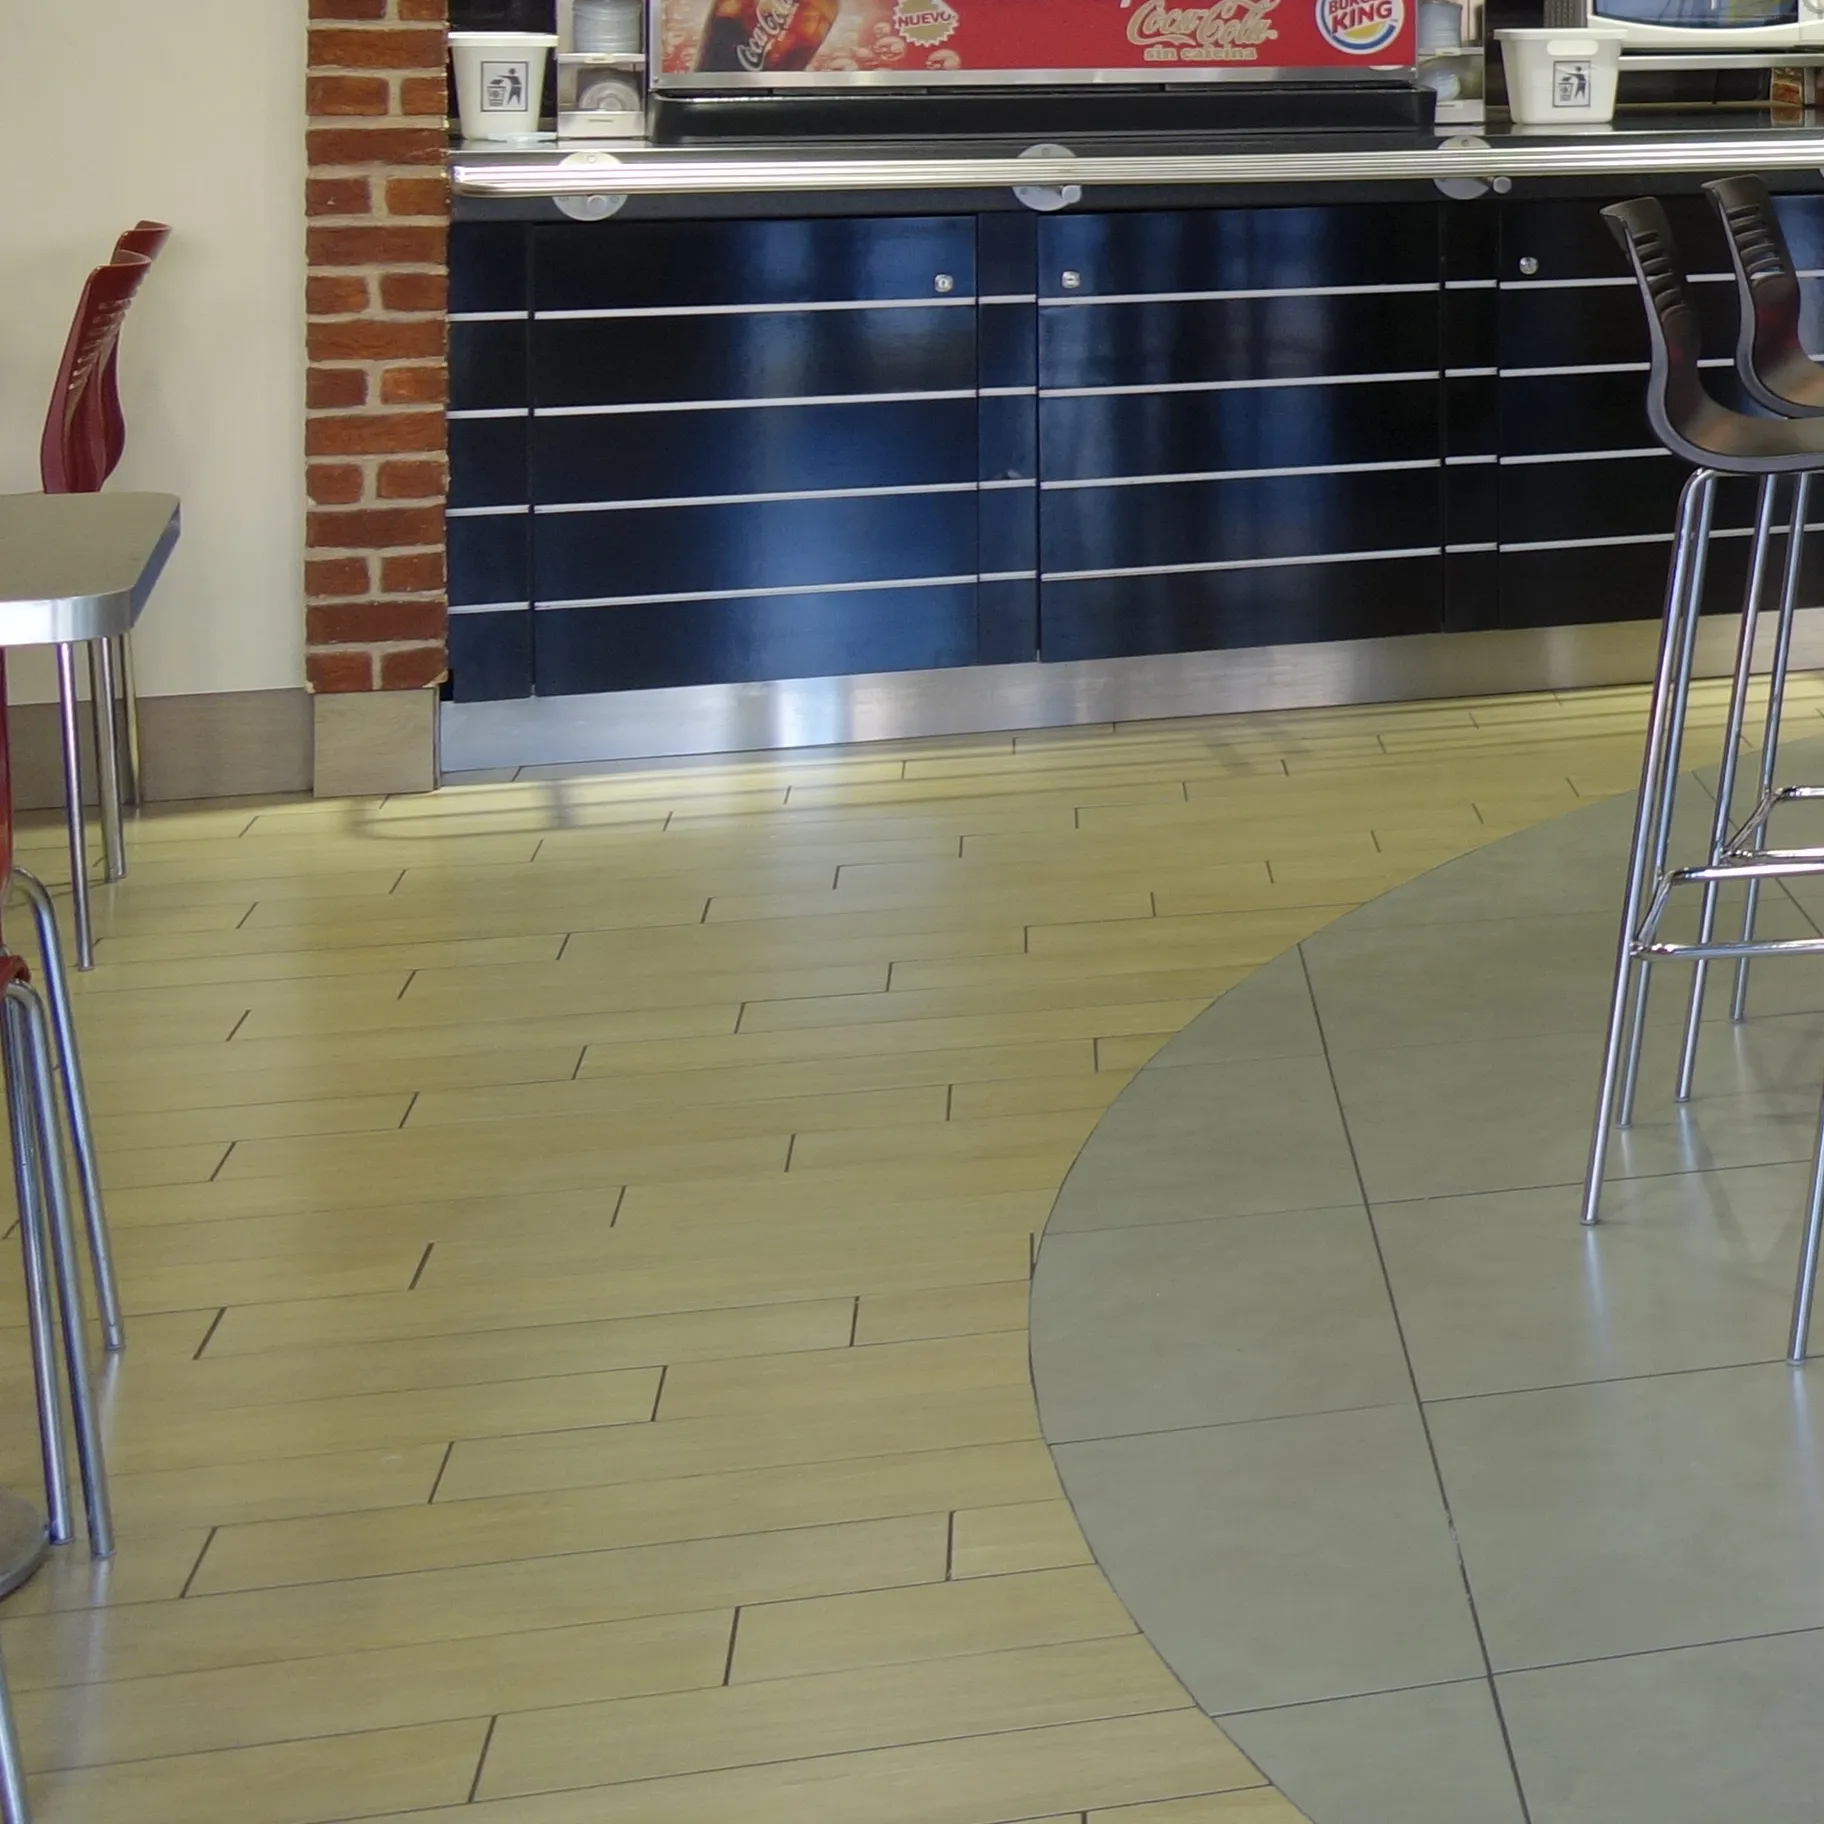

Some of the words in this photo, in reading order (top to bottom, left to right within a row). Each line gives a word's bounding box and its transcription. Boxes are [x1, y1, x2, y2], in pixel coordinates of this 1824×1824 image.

[898, 11, 953, 30] NUEVO
[1331, 0, 1393, 35] KING
[1144, 43, 1176, 62] sin
